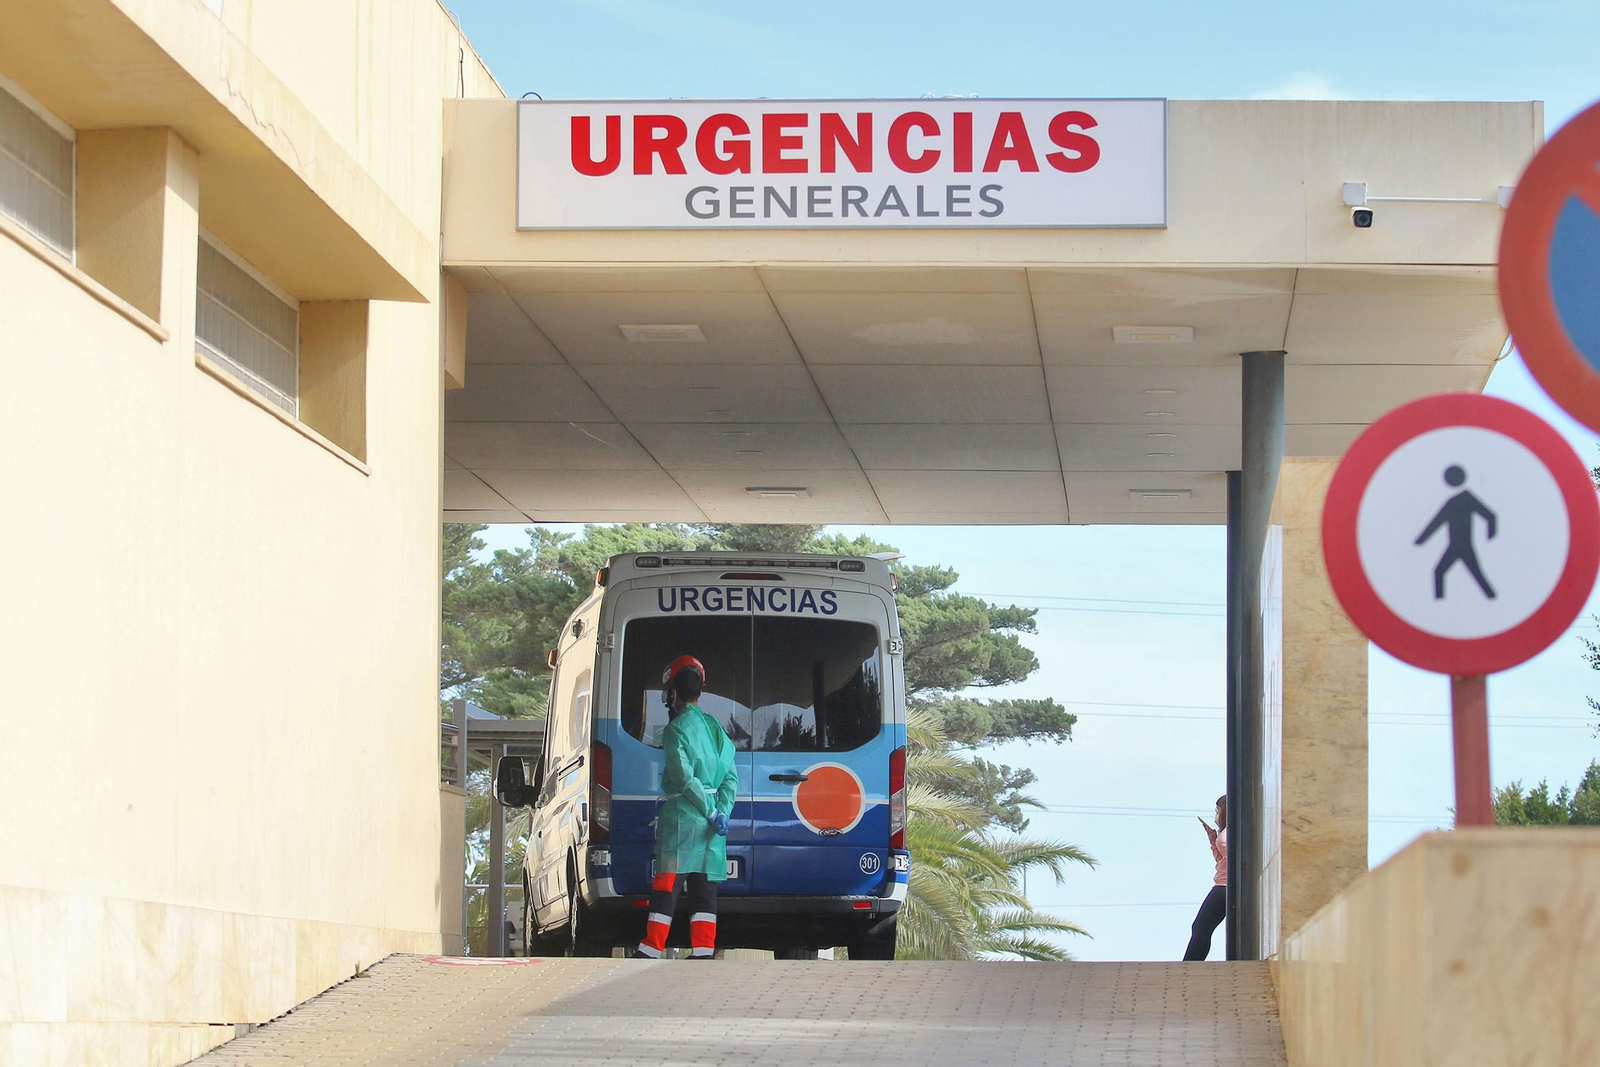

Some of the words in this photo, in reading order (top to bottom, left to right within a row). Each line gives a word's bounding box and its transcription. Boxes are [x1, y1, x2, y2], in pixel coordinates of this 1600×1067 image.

[571, 111, 1100, 177] URGENCIAS
[685, 184, 1004, 219] GENERALES
[658, 587, 838, 616] URGENCIAS
[861, 857, 877, 870] 301
